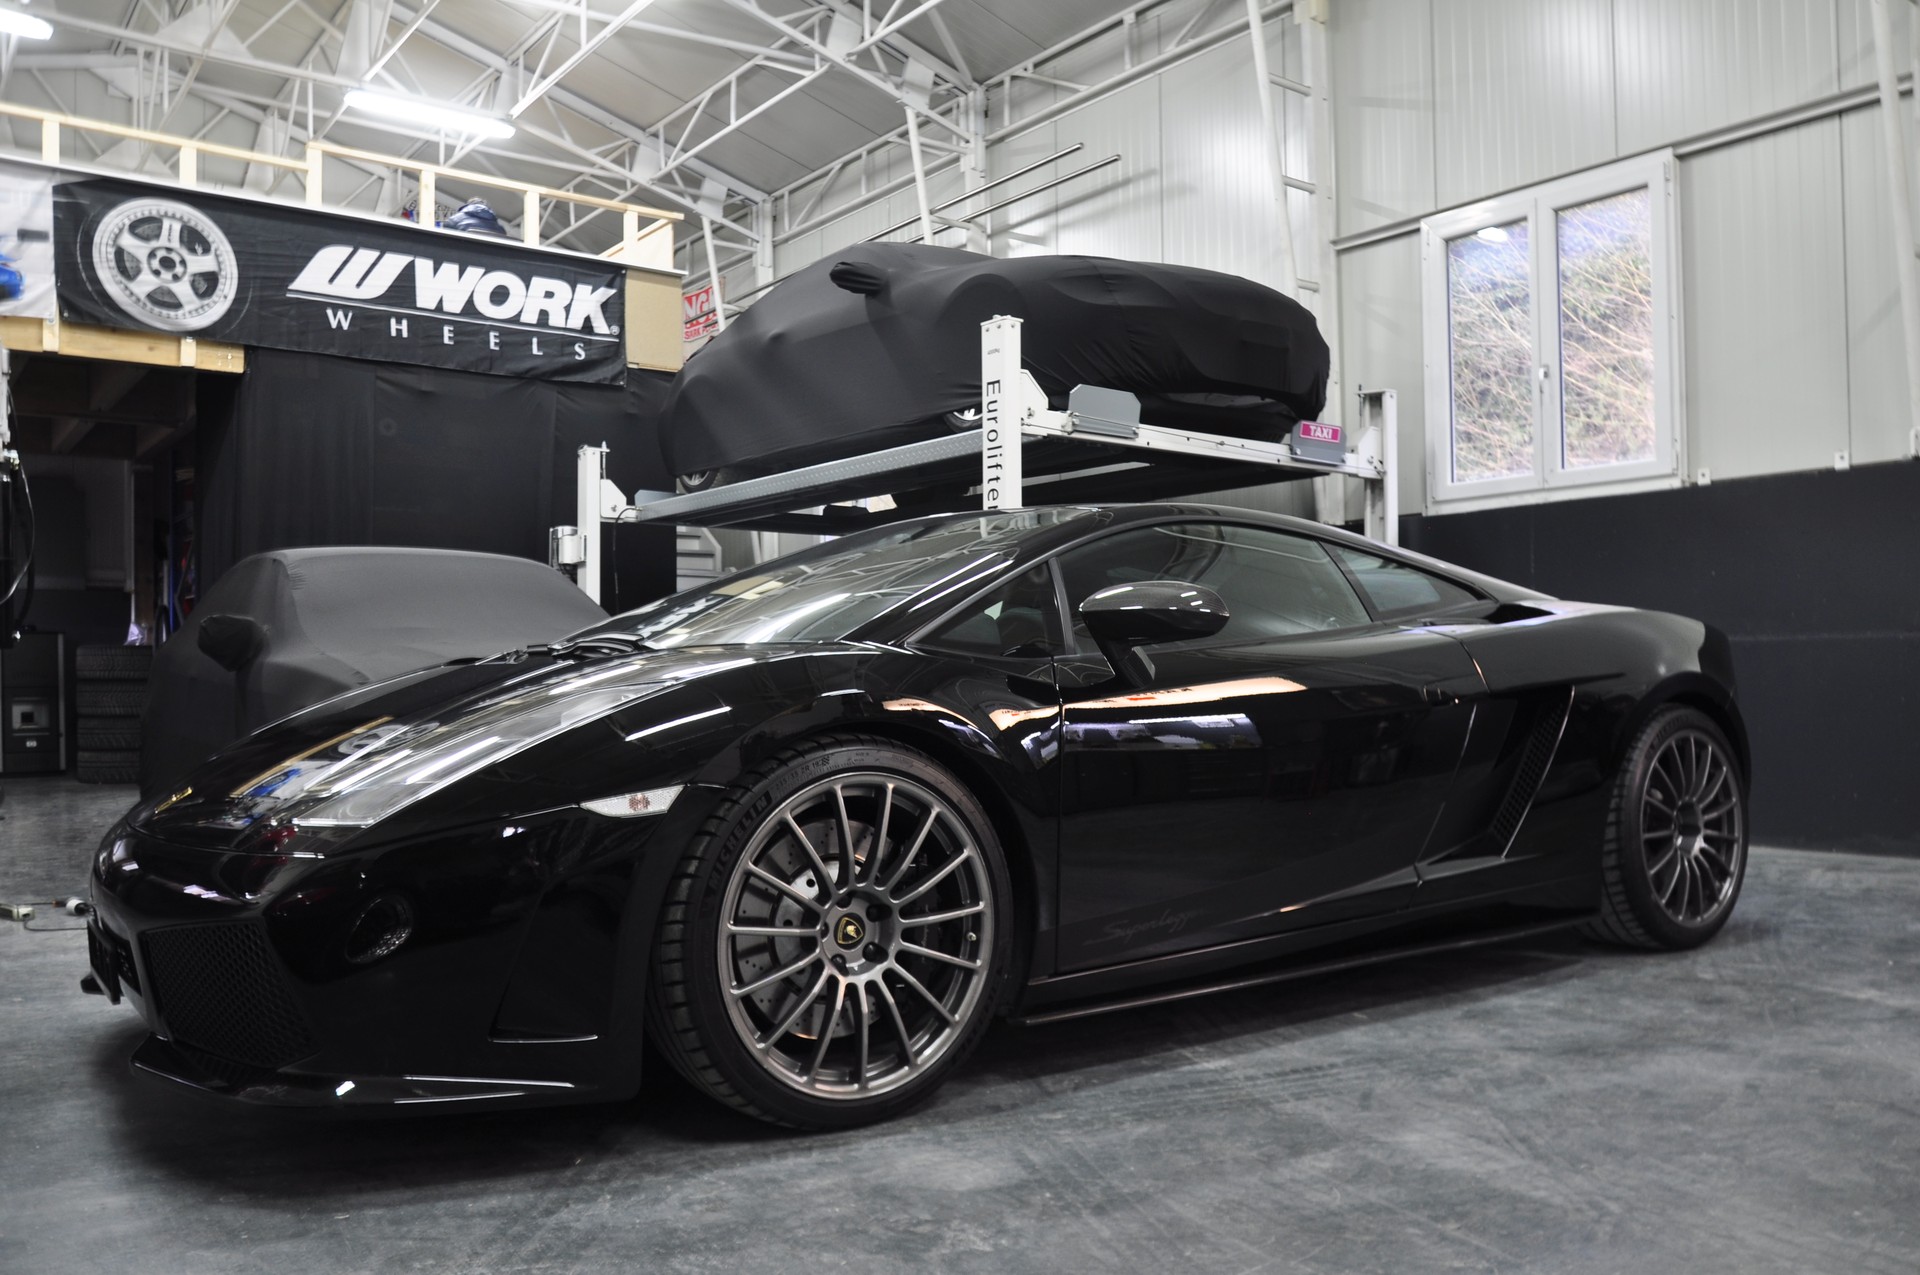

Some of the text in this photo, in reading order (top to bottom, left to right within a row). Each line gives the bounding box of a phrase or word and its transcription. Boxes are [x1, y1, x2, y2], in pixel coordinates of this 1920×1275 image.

[415, 257, 616, 334] WORK
[327, 307, 586, 361] WHEELS
[1309, 425, 1333, 439] TAXI
[707, 792, 770, 890] MICHELIN
